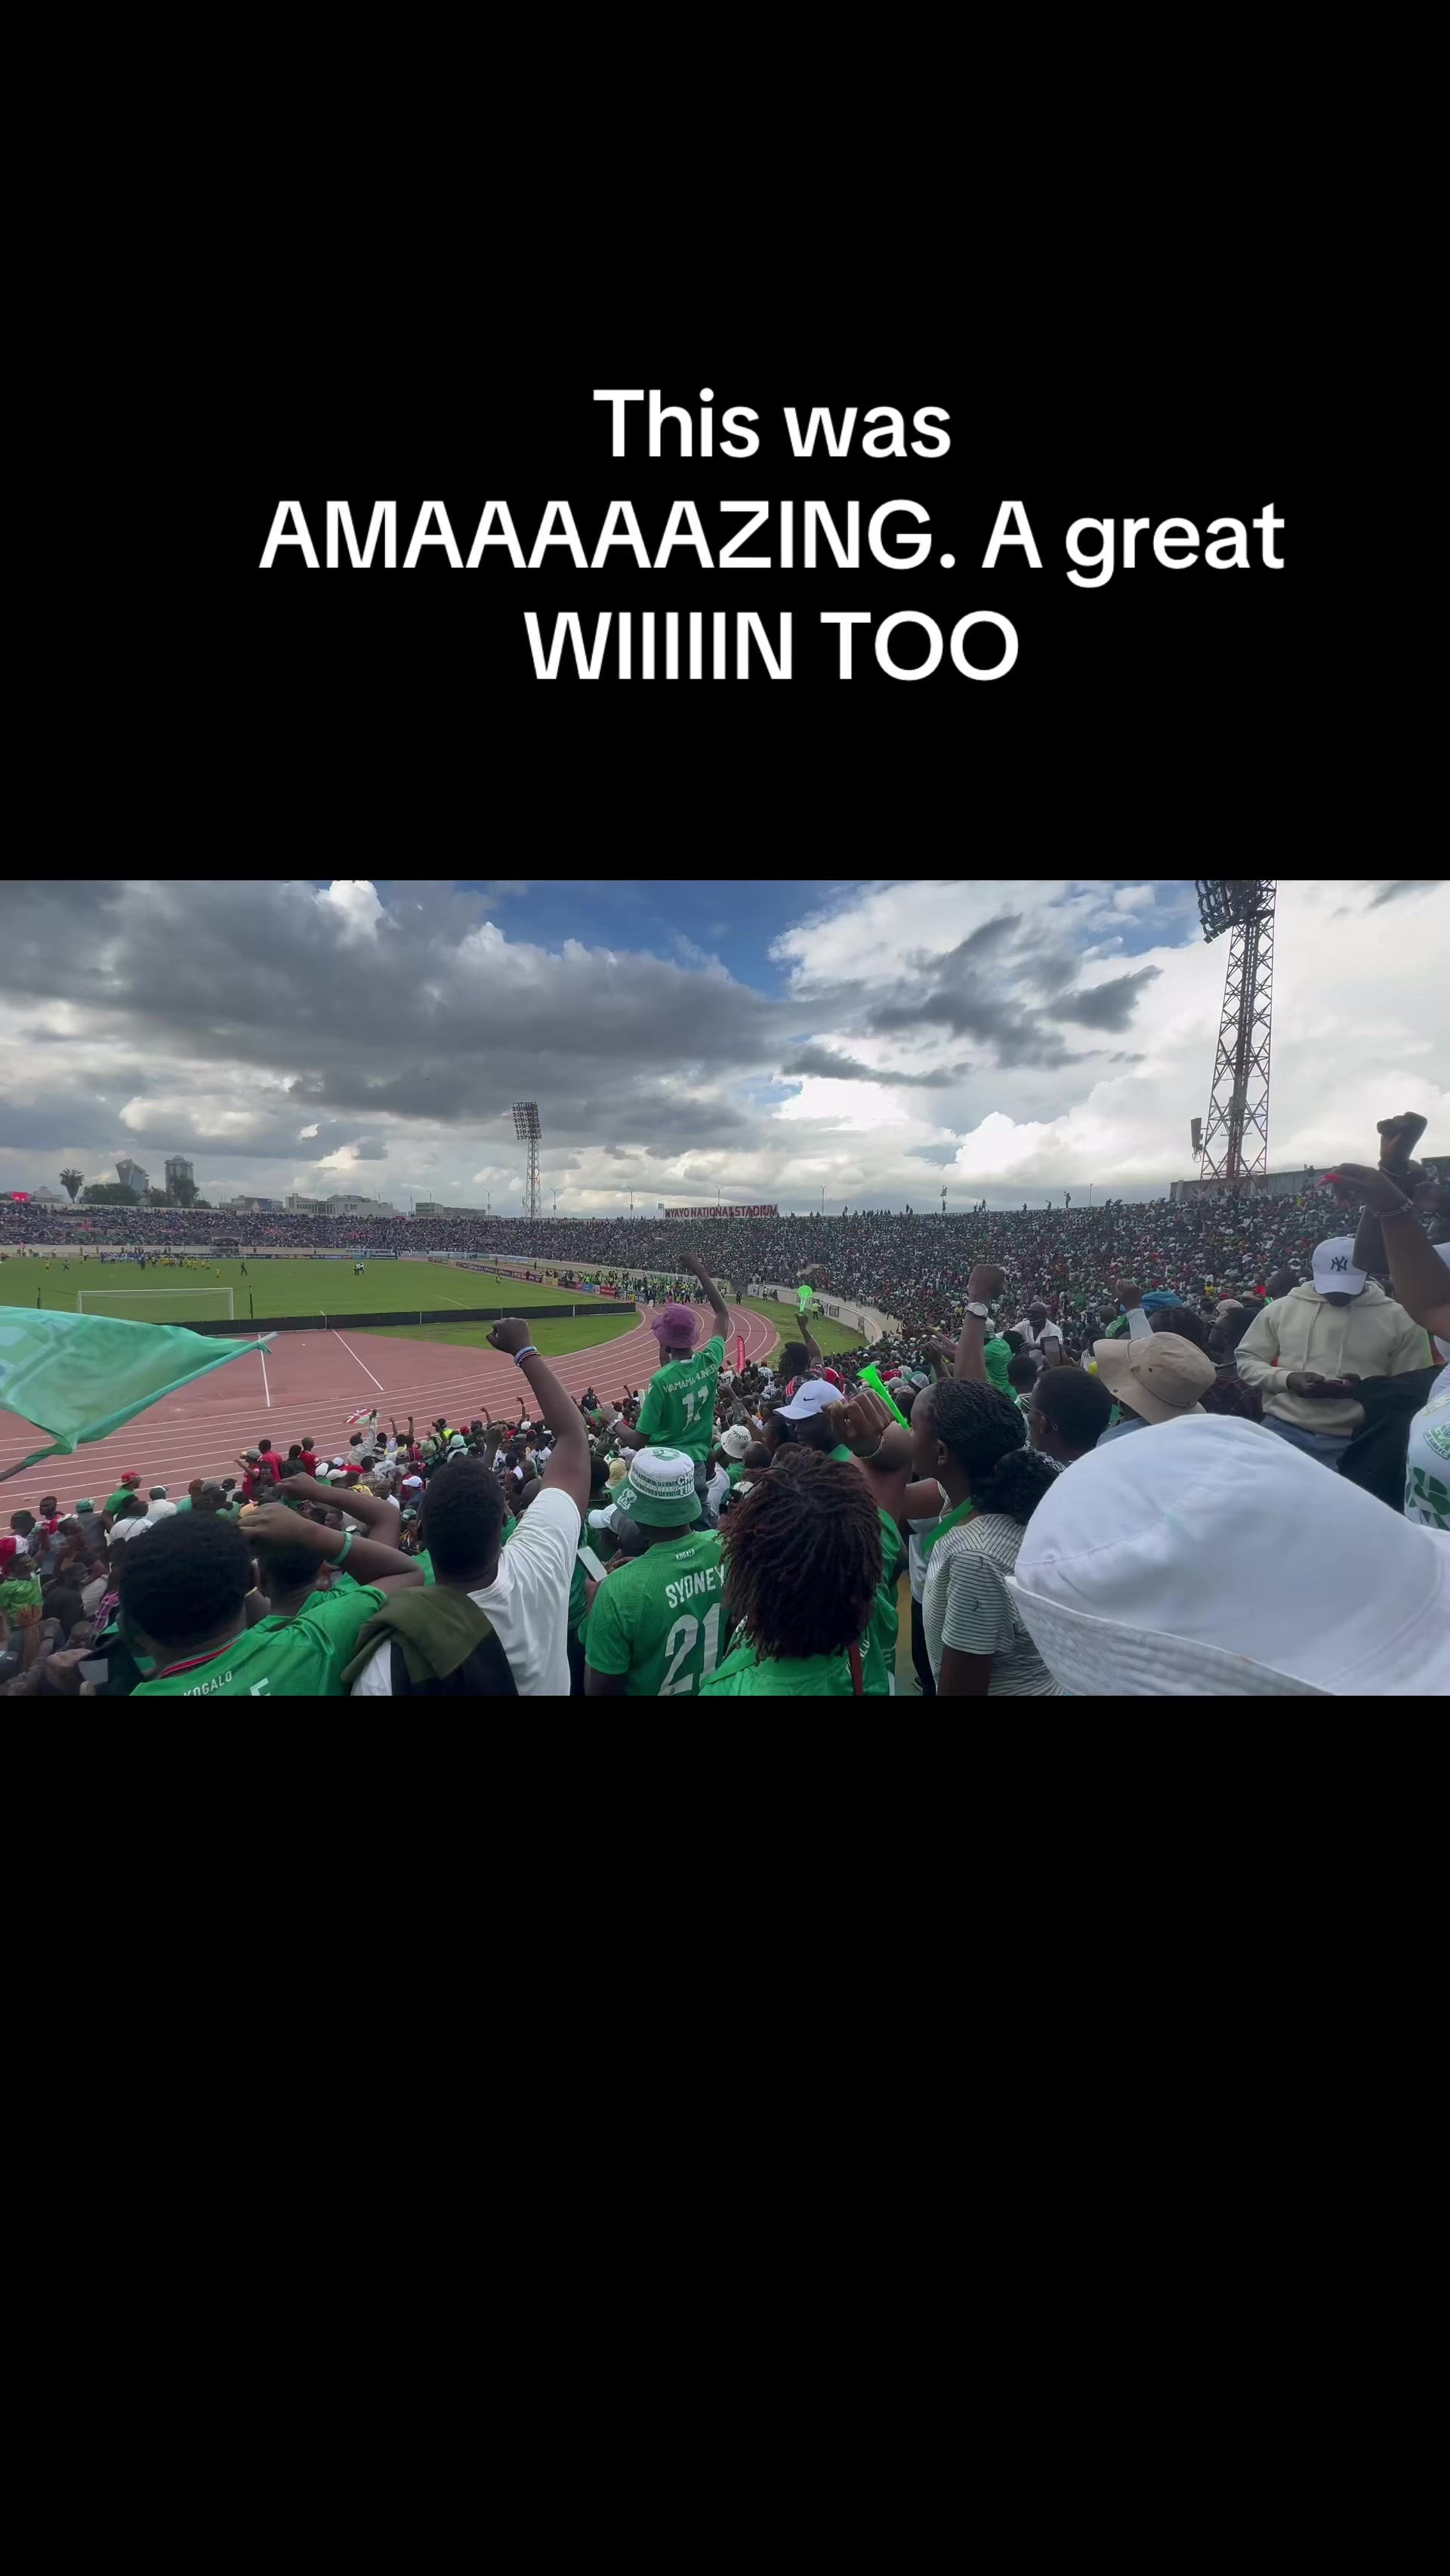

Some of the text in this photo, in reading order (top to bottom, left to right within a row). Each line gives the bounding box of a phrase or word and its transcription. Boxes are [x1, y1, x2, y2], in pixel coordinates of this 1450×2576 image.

[665, 1208, 690, 1218] NYAYO
[735, 1204, 778, 1218] STADIUM
[675, 1548, 696, 1561] KOGALO
[665, 1564, 725, 1609] SYDNEY
[657, 1602, 720, 1696] 21
